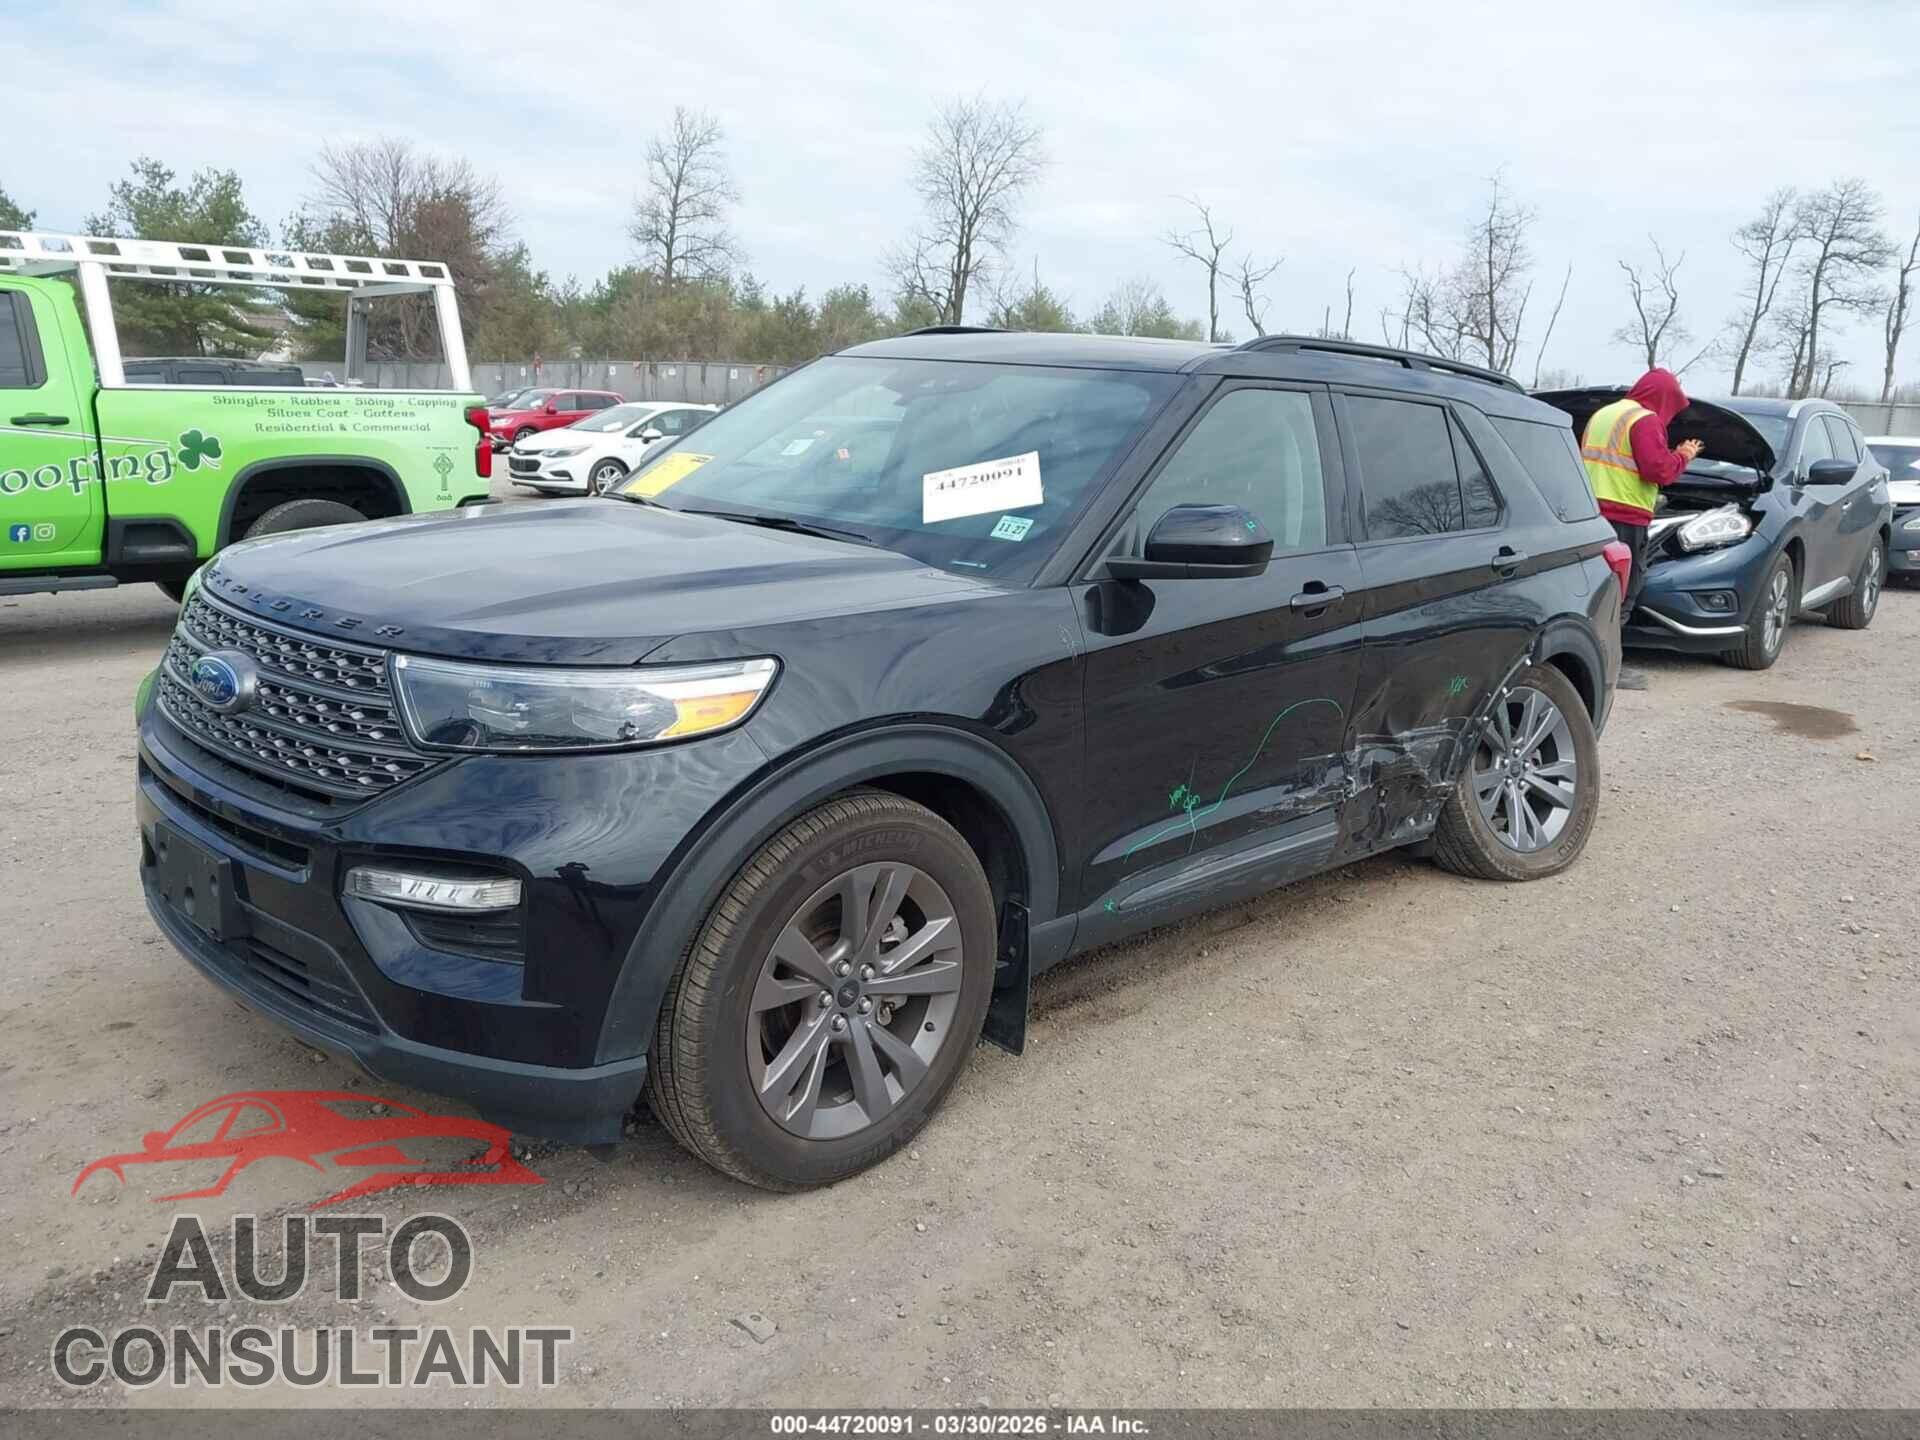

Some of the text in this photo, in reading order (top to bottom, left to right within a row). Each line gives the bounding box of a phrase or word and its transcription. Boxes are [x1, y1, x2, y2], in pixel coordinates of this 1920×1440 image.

[213, 396, 276, 408] Shingles
[290, 397, 341, 406] Rubber
[355, 397, 394, 408] Siding
[408, 397, 457, 408] Capping
[267, 408, 311, 418] Silver
[317, 408, 349, 418] Coat
[363, 408, 416, 418] Gutters
[255, 423, 335, 433] Residential
[353, 423, 432, 433] Commercial
[935, 467, 1023, 491] 44720091
